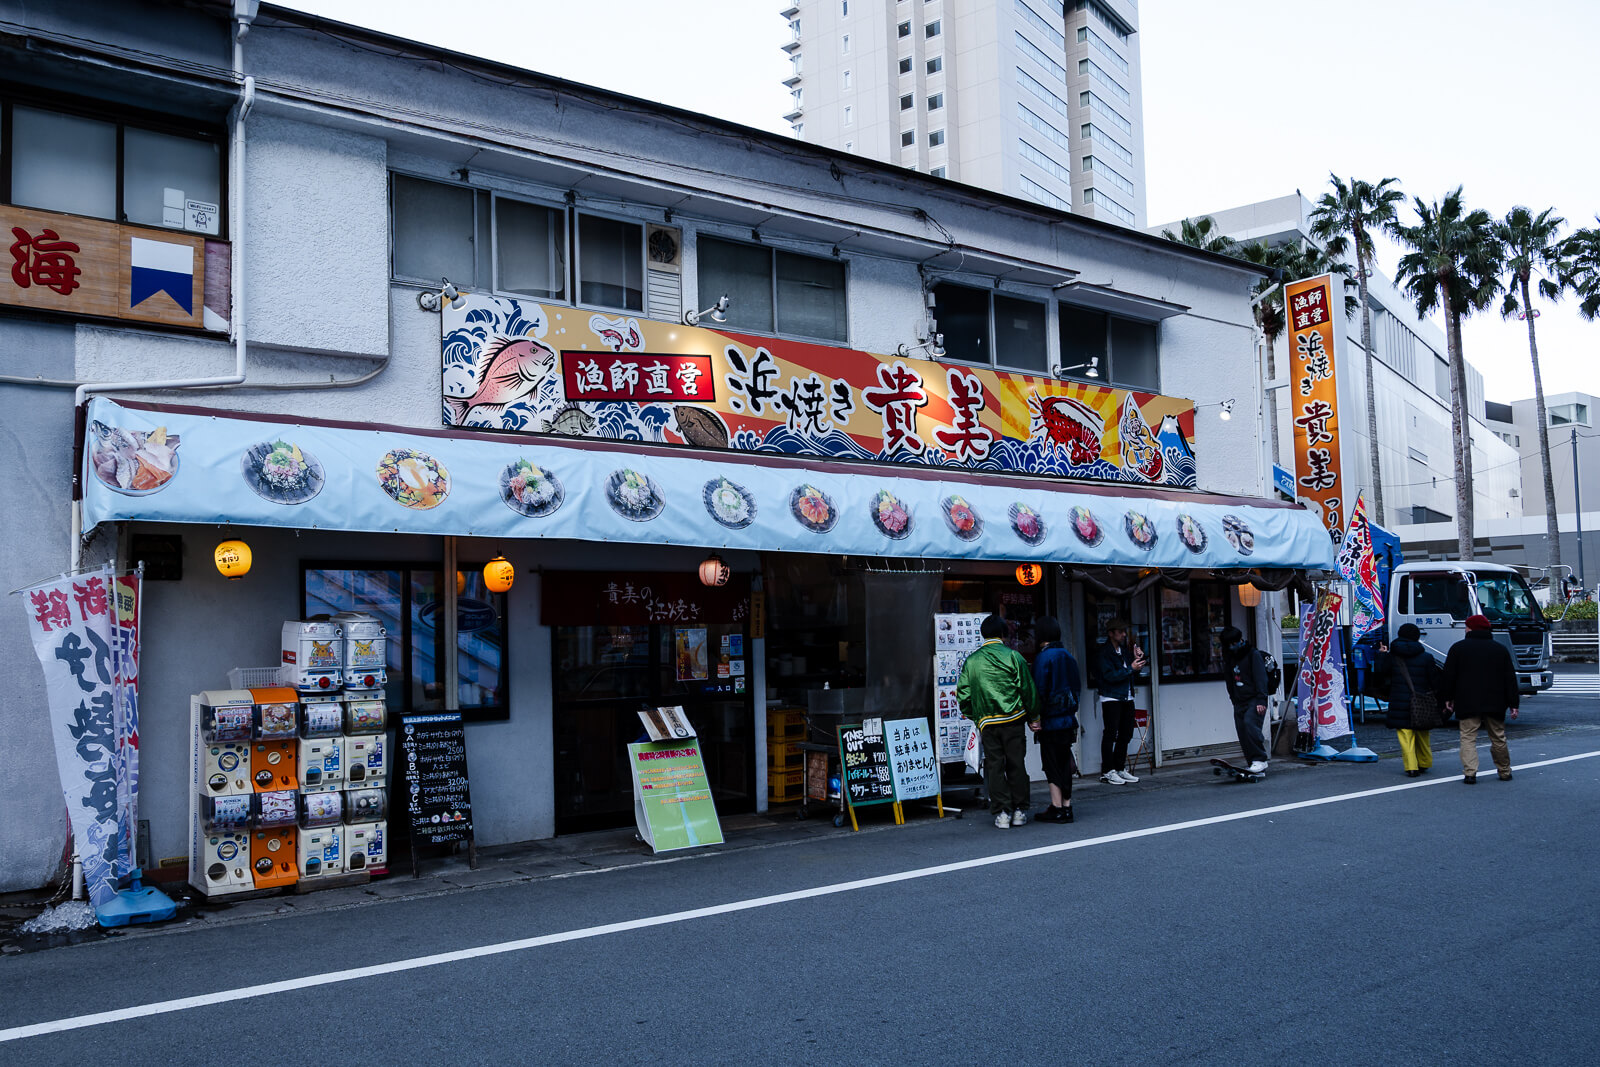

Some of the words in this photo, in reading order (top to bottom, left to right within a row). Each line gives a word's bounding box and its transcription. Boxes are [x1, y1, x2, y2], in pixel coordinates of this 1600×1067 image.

[9, 226, 82, 296] 海
[1294, 290, 1323, 312] 漁師
[1296, 309, 1324, 329] 直営
[1297, 330, 1332, 395] 浜焼き
[575, 358, 703, 396] 漁師直営
[726, 347, 852, 435] 浜焼き
[864, 364, 990, 460] 貴美
[1295, 400, 1336, 490] 貴美
[602, 581, 652, 605] 貴美の
[645, 596, 702, 622] 浜焼き
[1415, 617, 1443, 625] 熱海丸
[843, 729, 864, 742] TAKE
[894, 726, 920, 742] 当店は
[847, 740, 864, 752] OUT
[894, 740, 928, 757] 駐車場は
[409, 762, 416, 771] B
[412, 793, 418, 802] C
